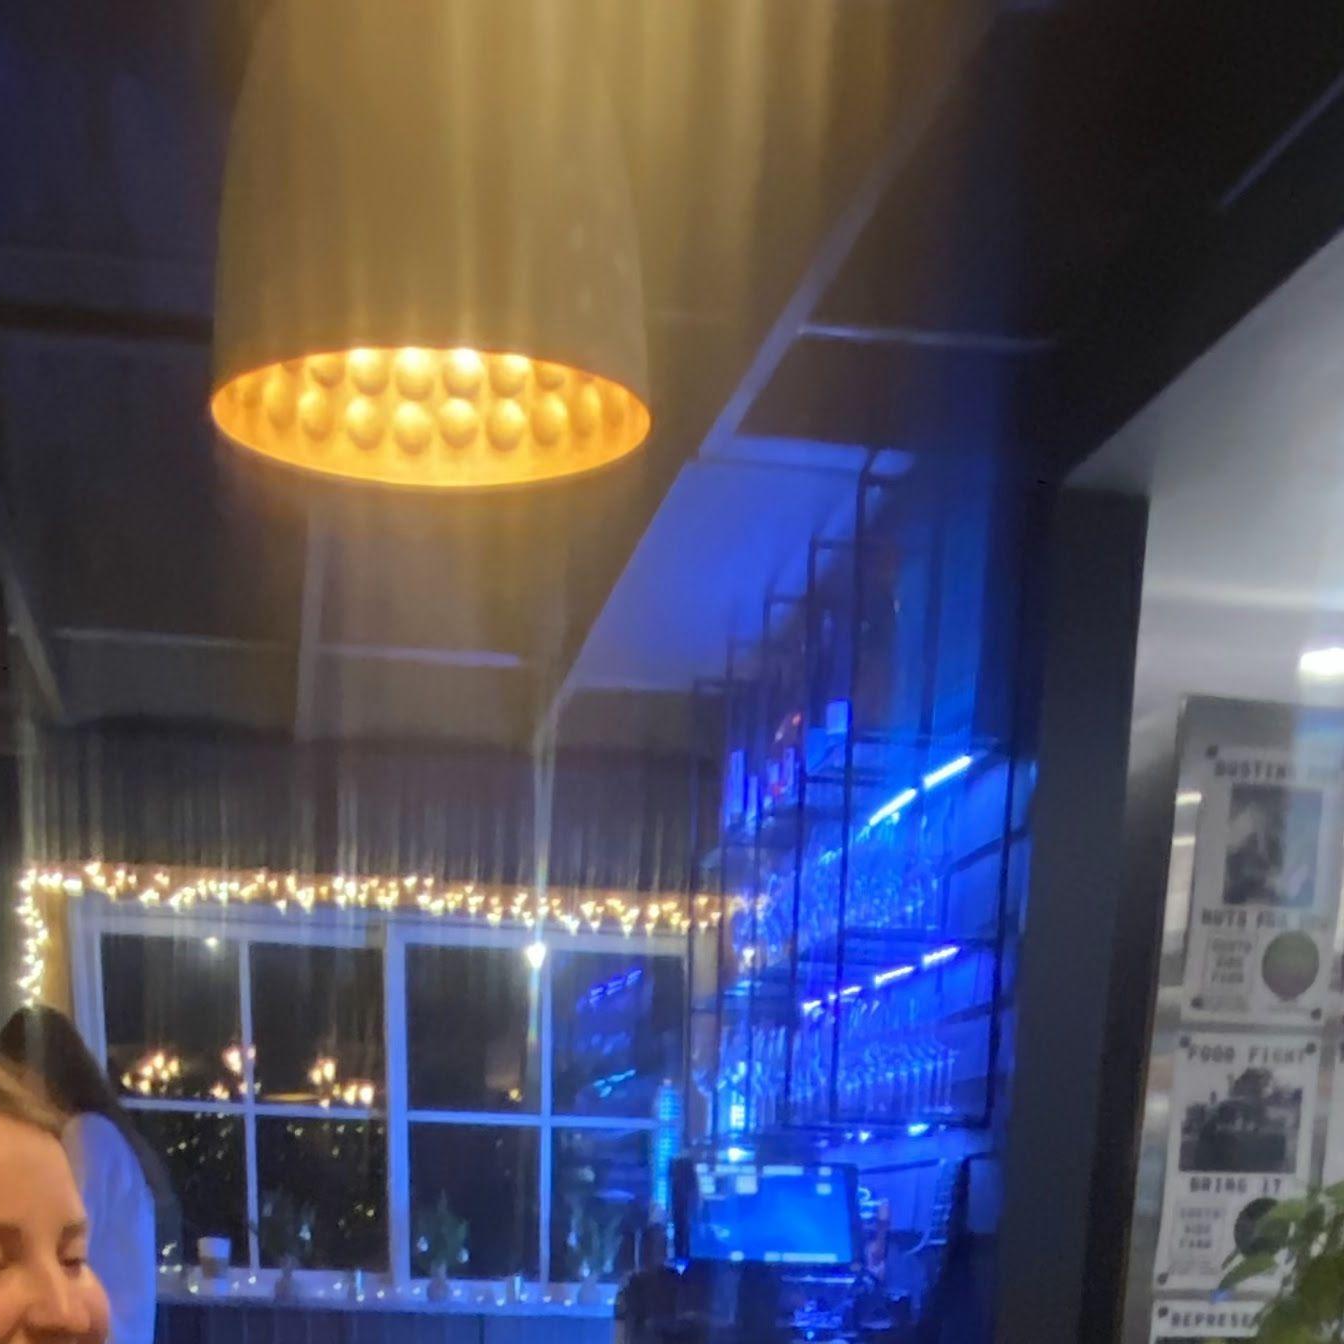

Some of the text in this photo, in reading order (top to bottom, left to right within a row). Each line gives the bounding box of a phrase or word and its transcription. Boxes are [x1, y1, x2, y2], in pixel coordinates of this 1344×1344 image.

[1188, 1045, 1304, 1065] FOOD FIGHT
[1190, 1176, 1282, 1194] BRING IT
